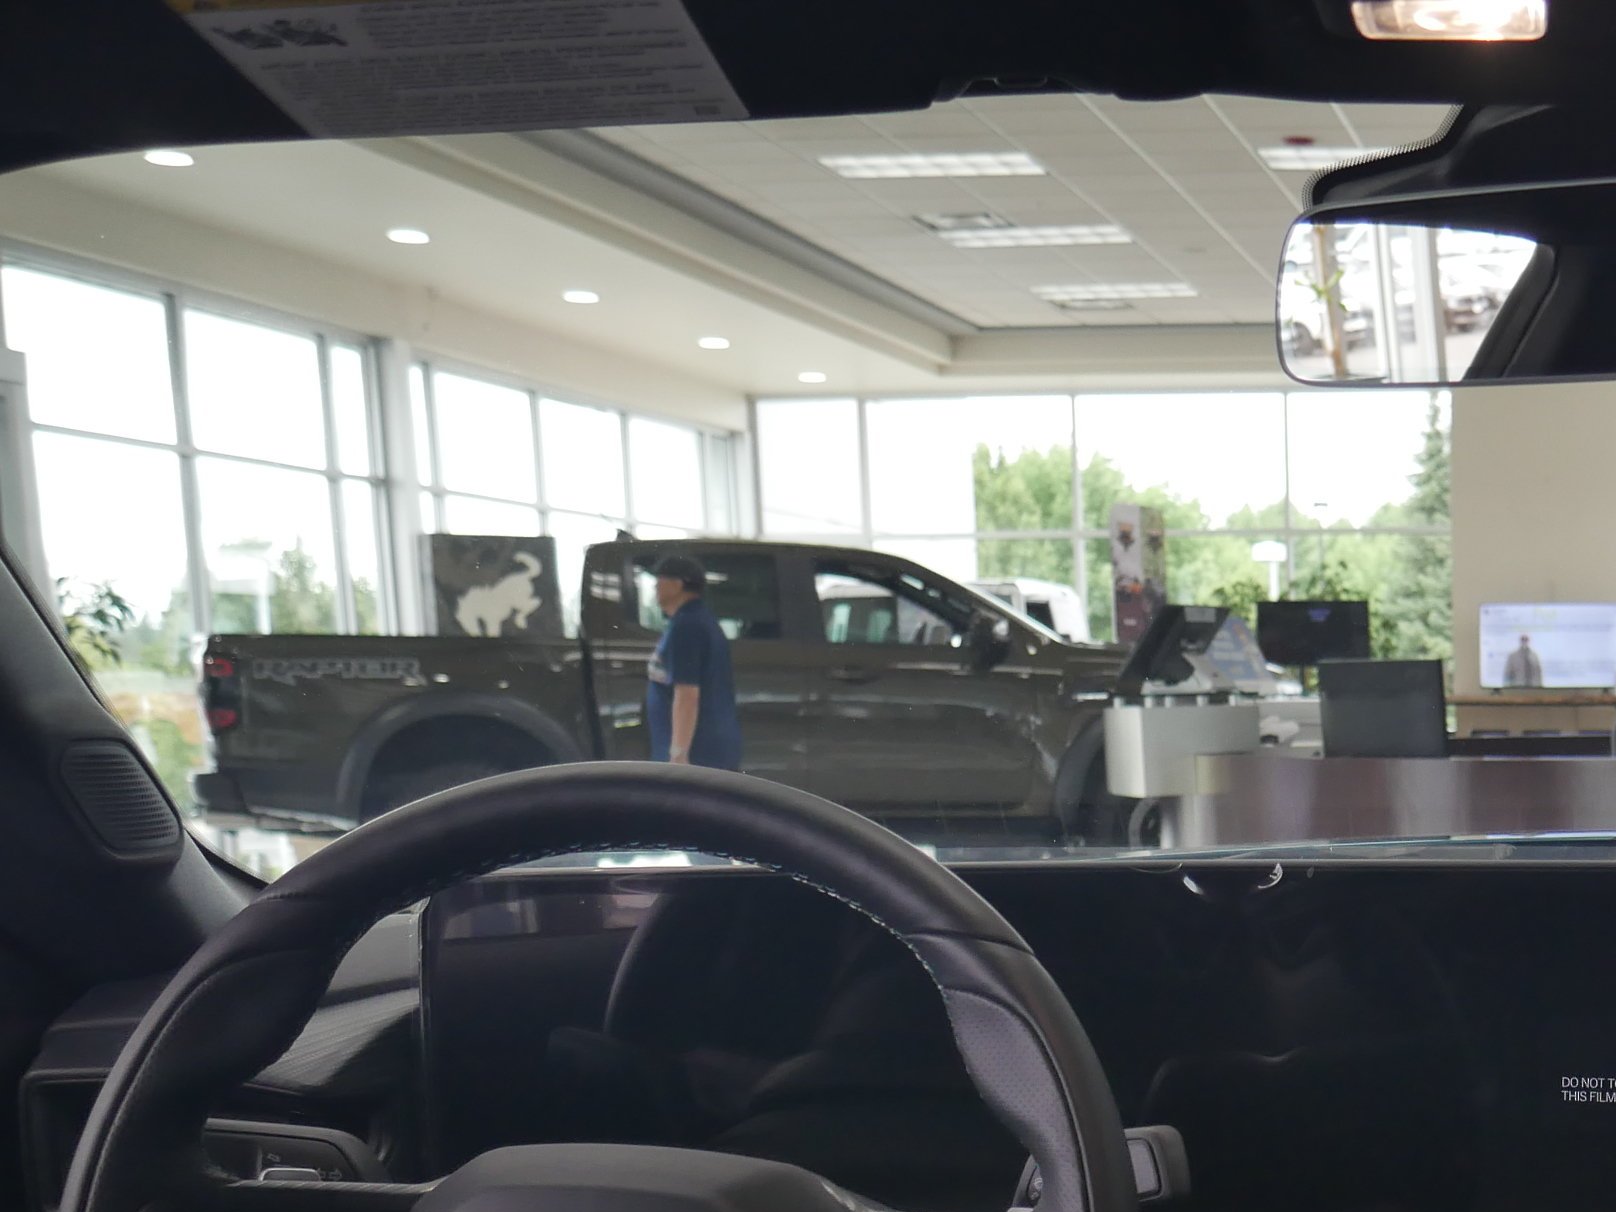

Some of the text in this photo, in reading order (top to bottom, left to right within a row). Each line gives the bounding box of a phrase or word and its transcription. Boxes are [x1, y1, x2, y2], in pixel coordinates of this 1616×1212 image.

[1561, 1076, 1579, 1088] DO
[1581, 1077, 1605, 1089] NOT
[1561, 1090, 1587, 1102] THIS
[1589, 1091, 1616, 1103] FILM
